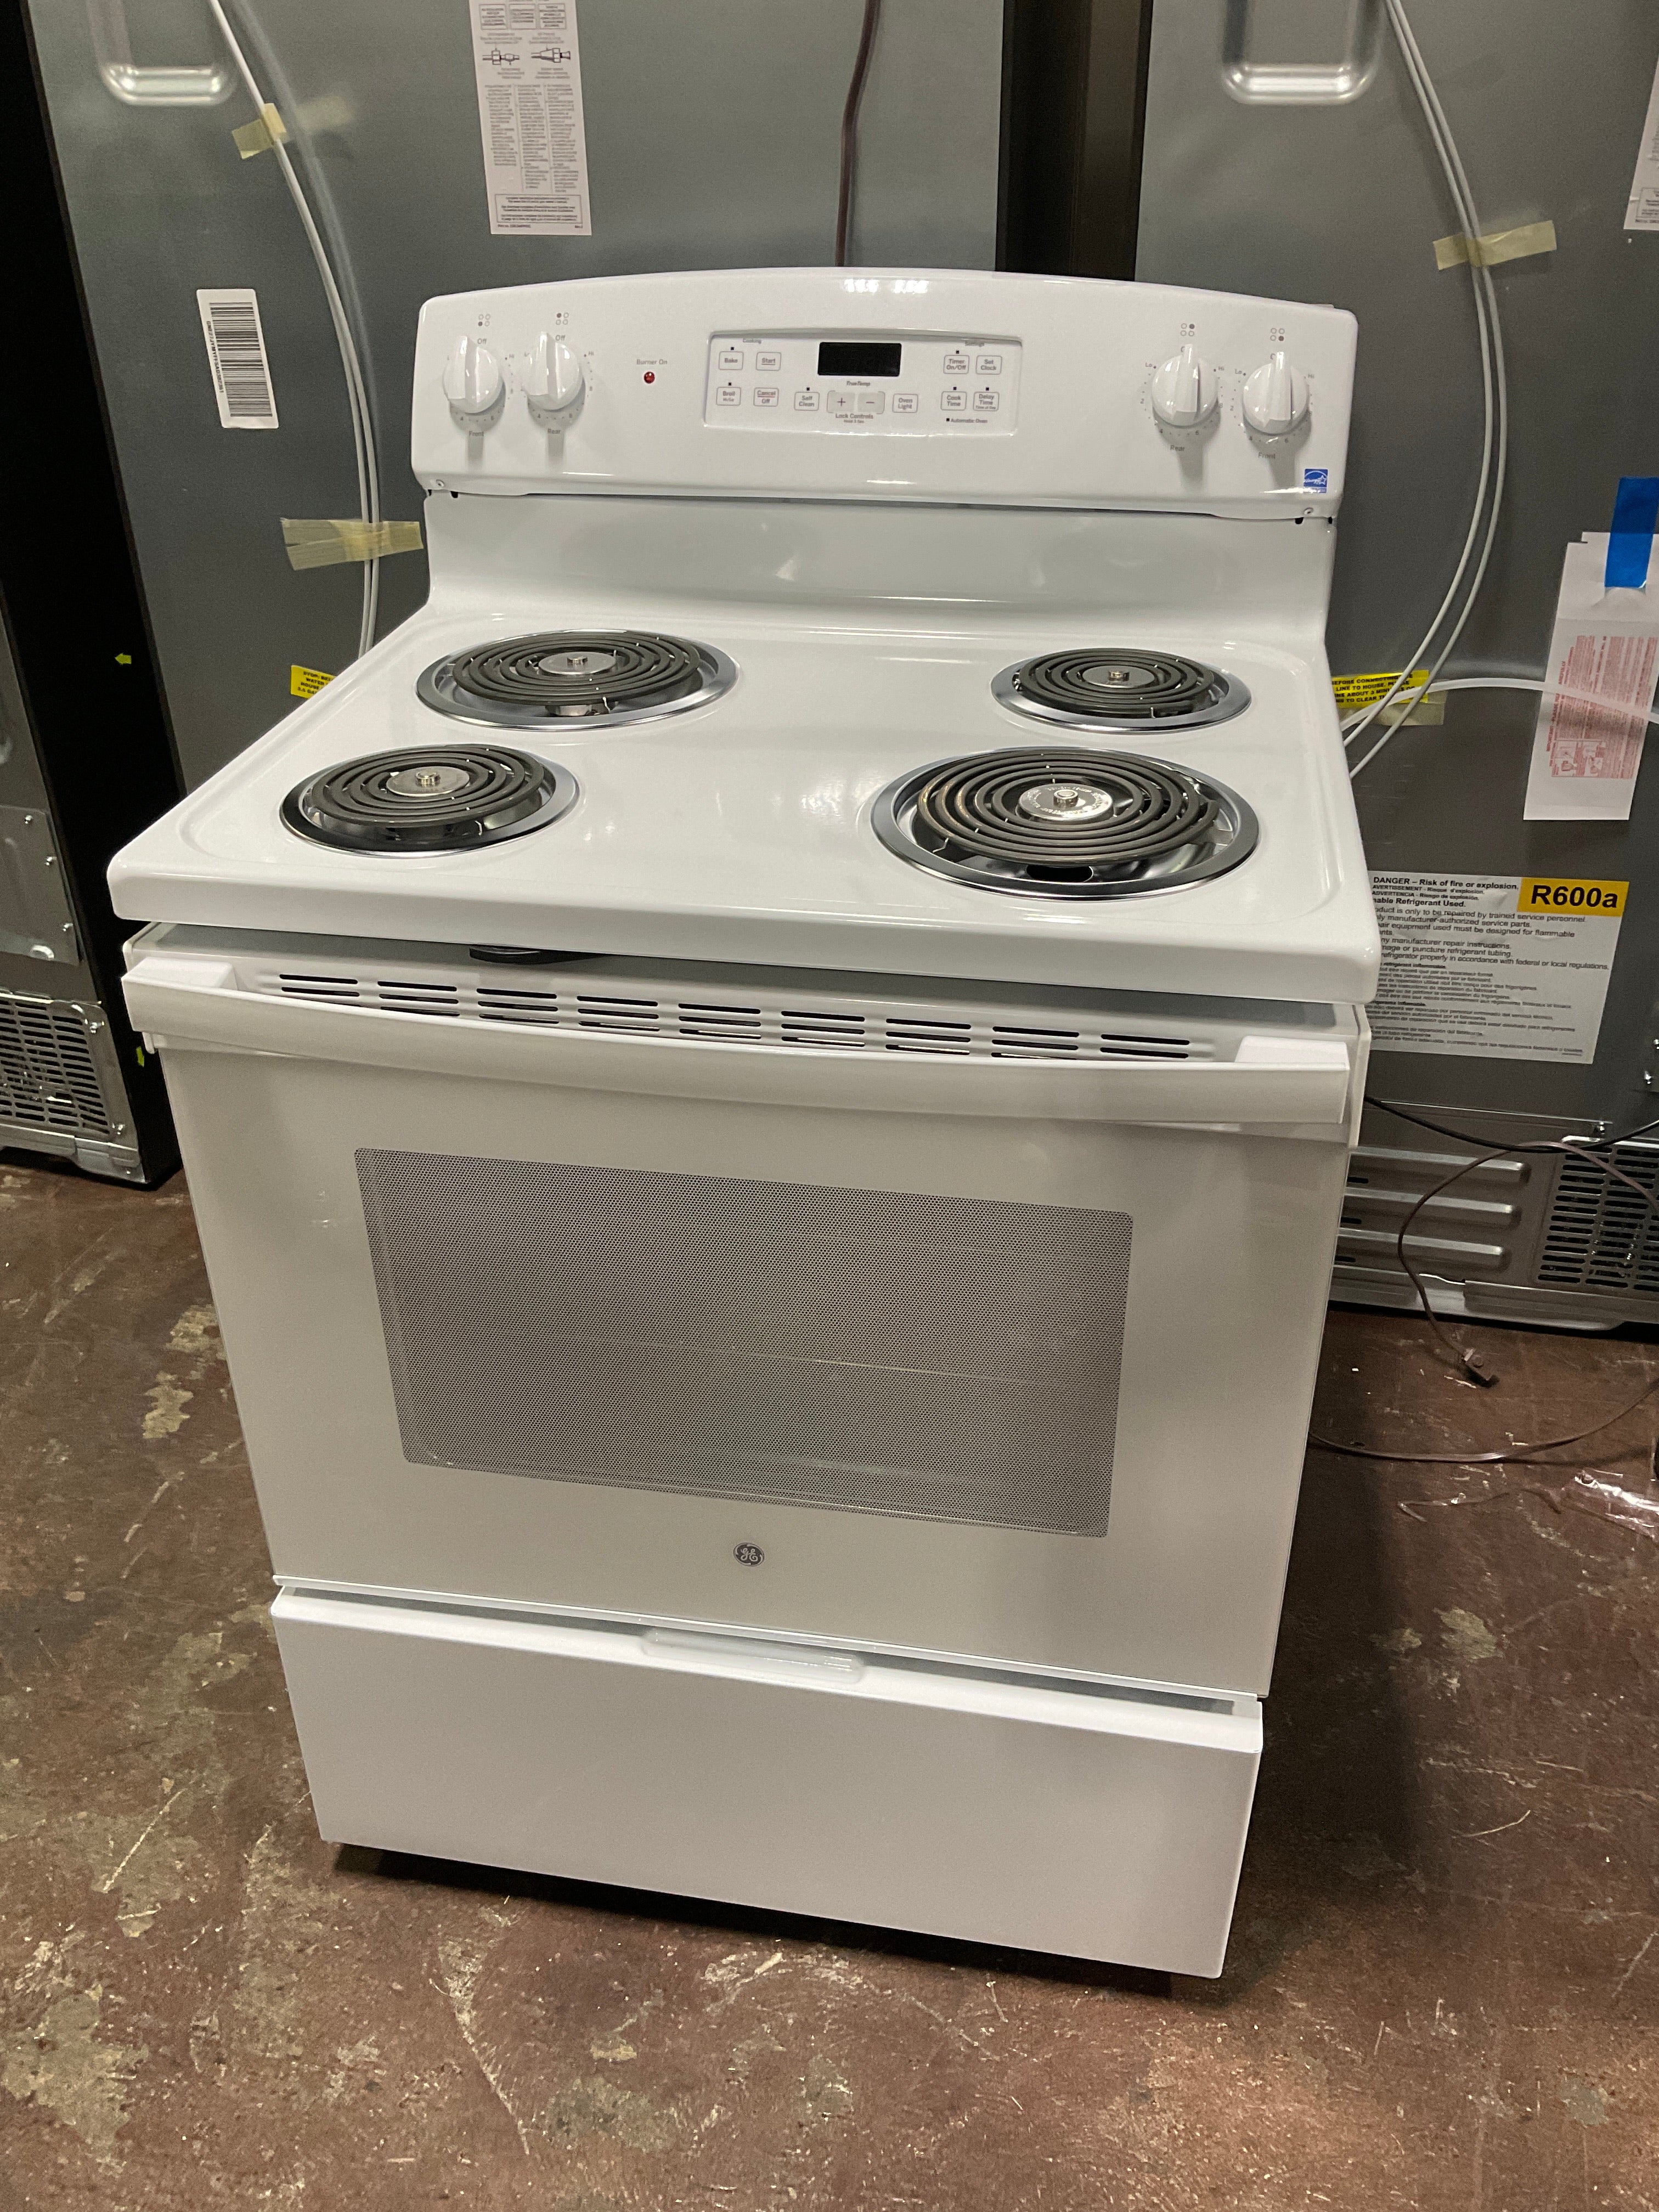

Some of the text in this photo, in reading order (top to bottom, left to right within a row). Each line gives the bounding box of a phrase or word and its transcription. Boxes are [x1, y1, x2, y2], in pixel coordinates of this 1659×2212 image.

[1257, 452, 1276, 460] Front
[1373, 877, 1410, 885] DANGER
[1419, 878, 1437, 887] Risk
[1477, 882, 1519, 890] explosion.
[1395, 898, 1441, 906] Refrigerant
[1531, 884, 1618, 909] R600a
[1391, 923, 1431, 932] equipment
[1486, 927, 1521, 936] designed
[1534, 929, 1576, 938] flammable
[1391, 938, 1442, 946] manufacturer
[1412, 946, 1446, 955] puncture
[1447, 948, 1486, 957] refrigerant
[1420, 953, 1448, 962] properly
[1458, 956, 1499, 965] accordance
